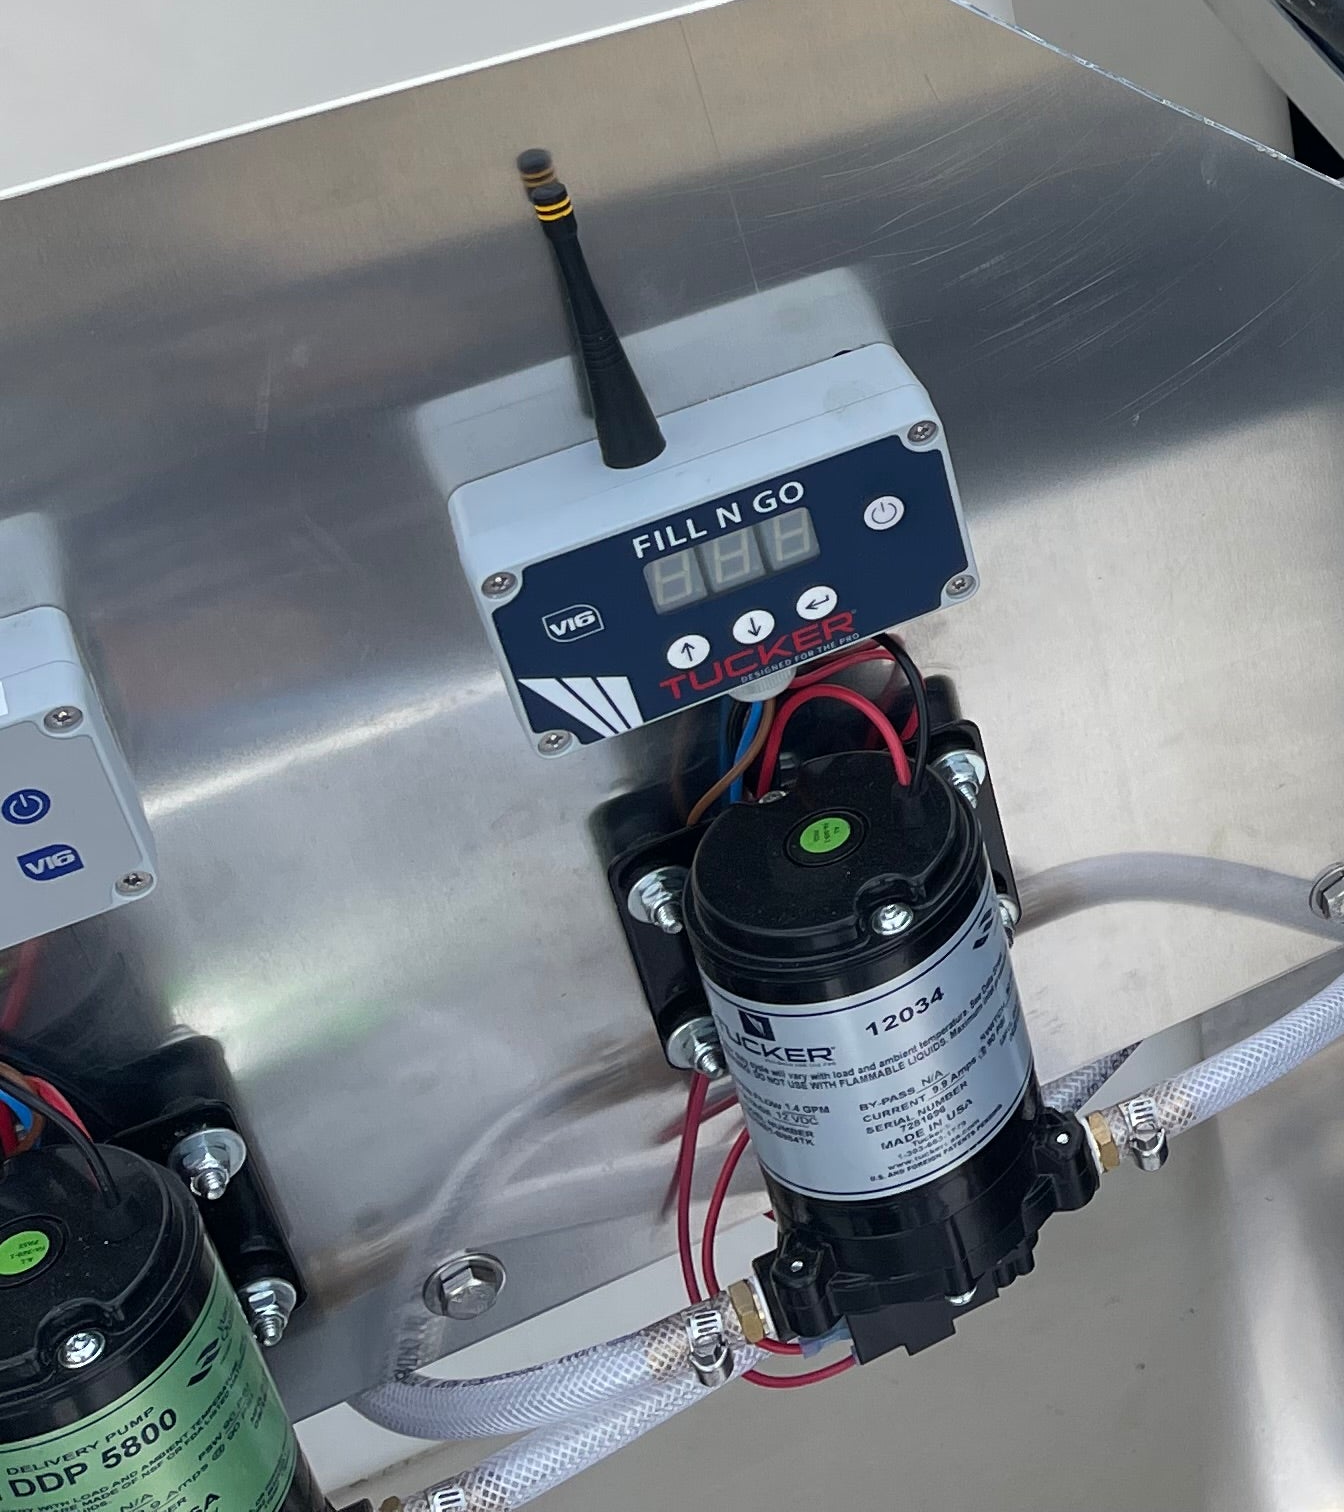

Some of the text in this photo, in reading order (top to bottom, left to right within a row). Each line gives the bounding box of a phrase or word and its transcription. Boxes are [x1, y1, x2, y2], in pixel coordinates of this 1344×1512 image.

[632, 481, 804, 559] FILL N GO
[659, 610, 855, 700] TUCKER
[740, 632, 861, 684] DESIGNED FOR THE PRO
[865, 986, 945, 1037] 12034
[787, 1079, 808, 1090] USE
[810, 1081, 837, 1090] WITH
[839, 1061, 905, 1089] FLAMMABLE
[810, 1070, 831, 1080] with
[832, 1067, 855, 1079] load
[858, 1061, 877, 1075] and
[879, 1045, 918, 1068] ambient
[803, 1105, 830, 1114] GPM
[859, 1069, 944, 1112] BY-PASS N/A
[863, 1094, 926, 1123] CURRENT
[950, 1056, 977, 1083] Amps
[866, 1080, 968, 1135] SERIAL NUMBER
[776, 1111, 788, 1121] 12
[881, 1099, 973, 1151] MADE IN USA
[887, 1168, 905, 1178] AND
[6, 1406, 155, 1476] DELIVERY PUMP
[8, 1408, 177, 1498] DDP 5800
[73, 1486, 109, 1503] LOAD
[112, 1470, 138, 1489] AND
[141, 1431, 189, 1472] AMBIENT
[82, 1488, 119, 1506] MADE
[121, 1477, 138, 1490] OF
[141, 1461, 164, 1479] NSF
[166, 1445, 183, 1461] OR
[167, 1463, 209, 1500] Amps
